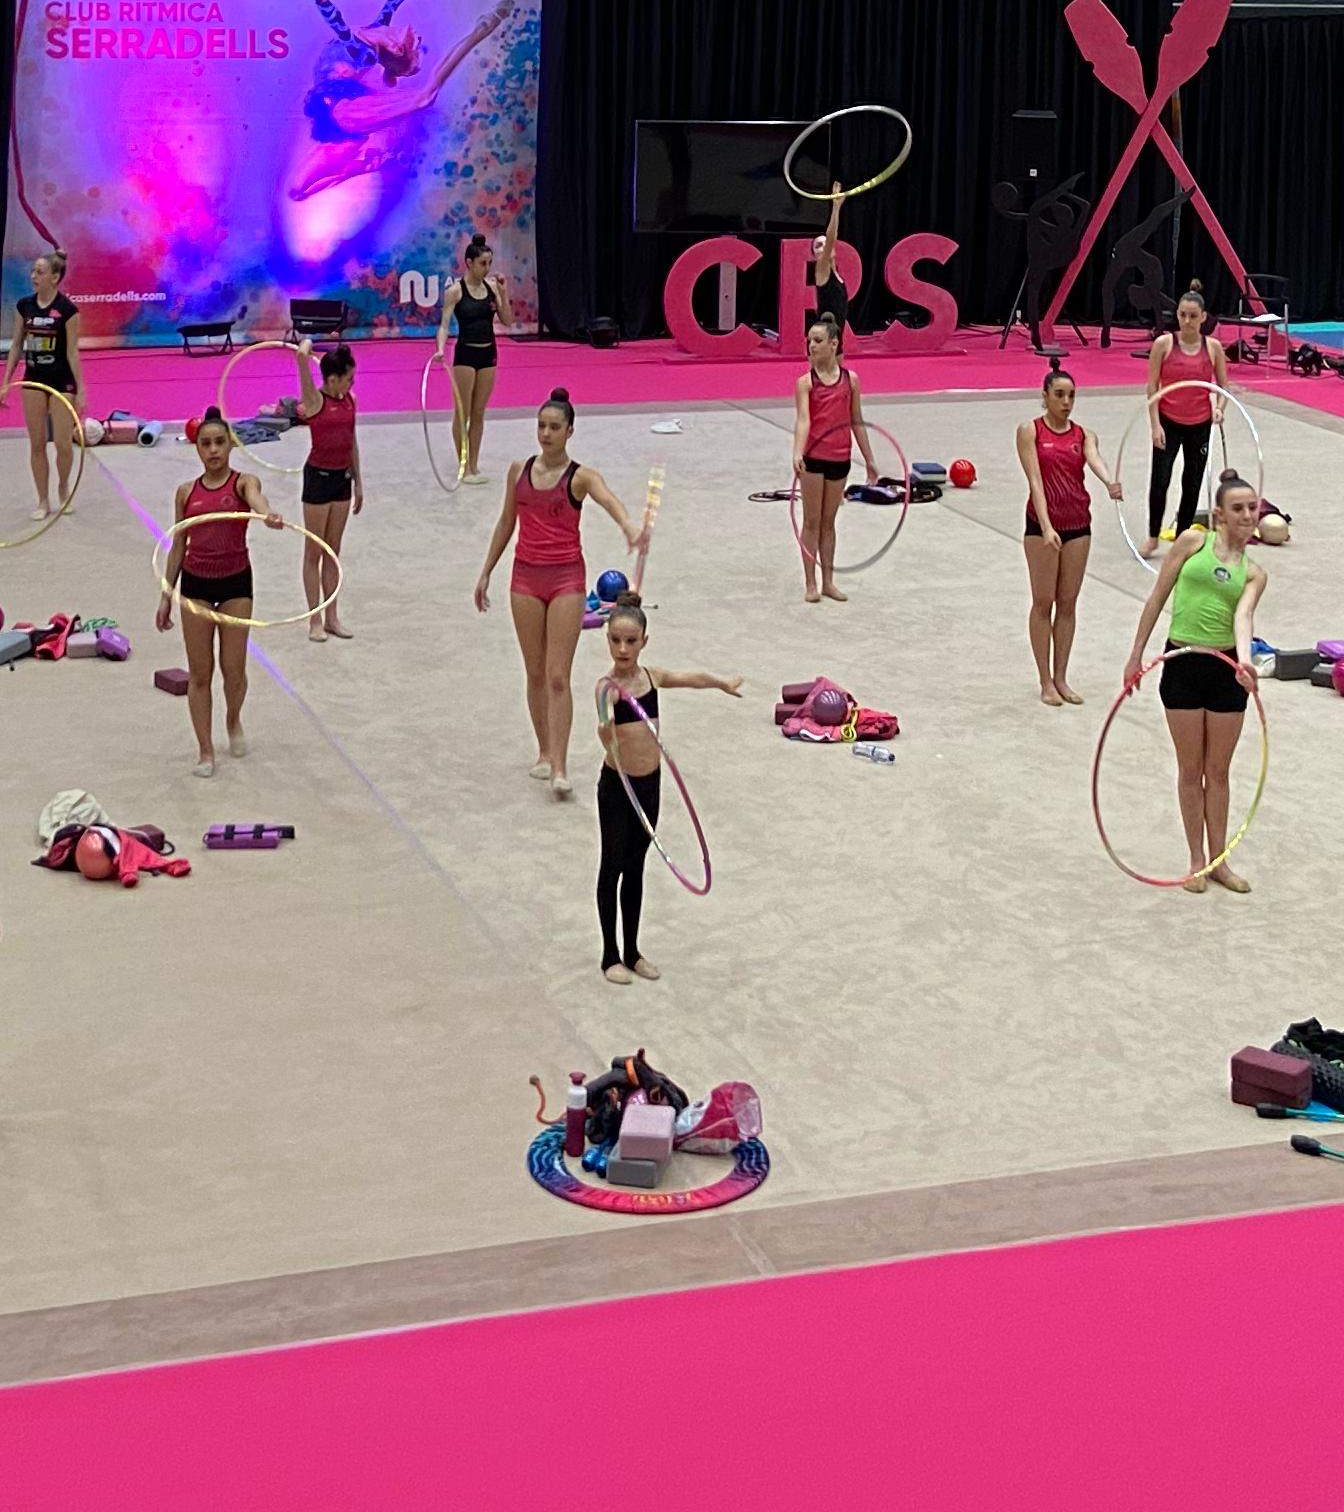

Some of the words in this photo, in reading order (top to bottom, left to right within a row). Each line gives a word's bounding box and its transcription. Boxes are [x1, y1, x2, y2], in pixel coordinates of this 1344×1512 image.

[45, 0, 111, 22] CLUB
[45, 27, 290, 59] SERRADELLS
[65, 291, 167, 303] caserradells.com
[663, 232, 960, 356] CRS
